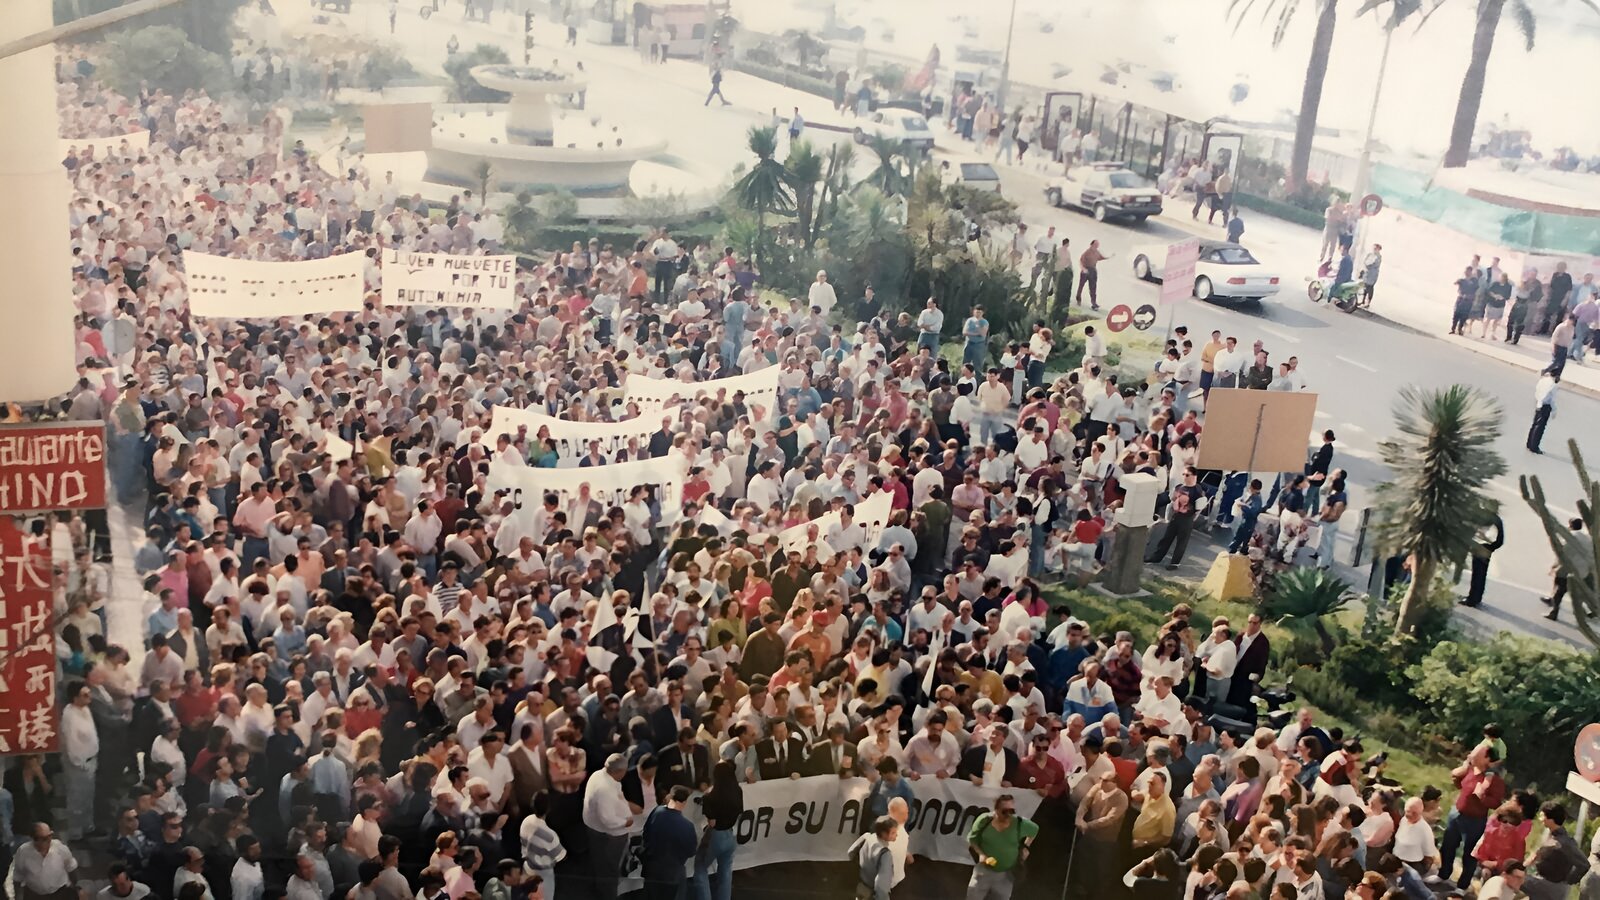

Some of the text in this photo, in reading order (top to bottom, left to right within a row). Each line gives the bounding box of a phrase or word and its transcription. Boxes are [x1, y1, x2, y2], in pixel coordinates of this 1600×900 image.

[444, 259, 512, 273] MUEVETE
[452, 274, 508, 288] POR TU
[735, 806, 774, 845] OR
[784, 801, 829, 835] SU
